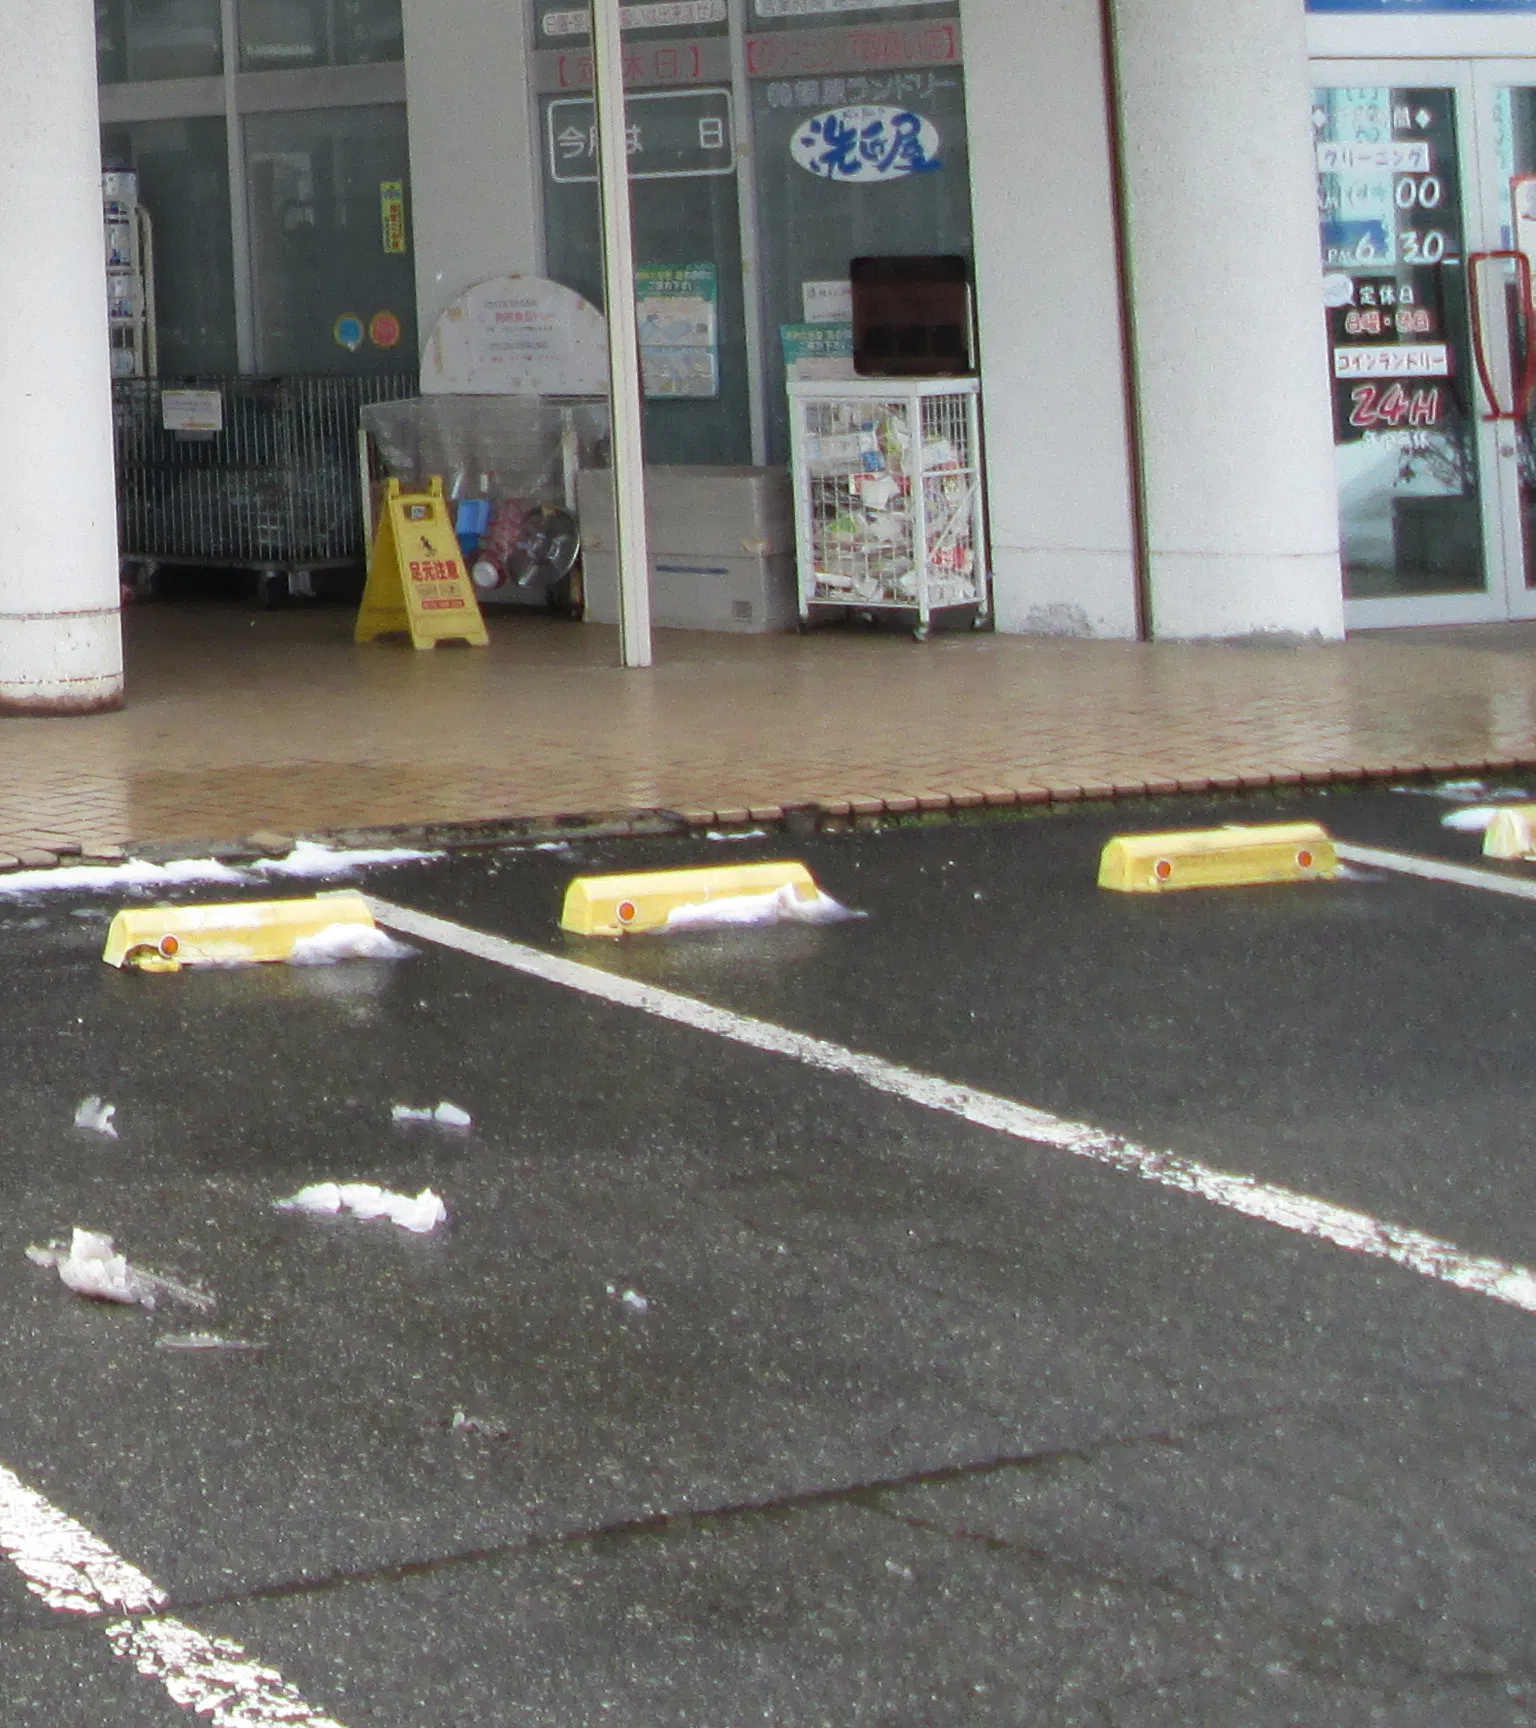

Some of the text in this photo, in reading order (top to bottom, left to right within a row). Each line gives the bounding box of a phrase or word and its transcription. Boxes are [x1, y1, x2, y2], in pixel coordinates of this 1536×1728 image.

[698, 117, 724, 150] 日
[1324, 148, 1423, 169] クリーニング
[1358, 285, 1415, 305] 定休日
[1336, 351, 1447, 372] コインランドリー
[1349, 382, 1440, 427] 24H
[409, 560, 460, 582] 足元注意
